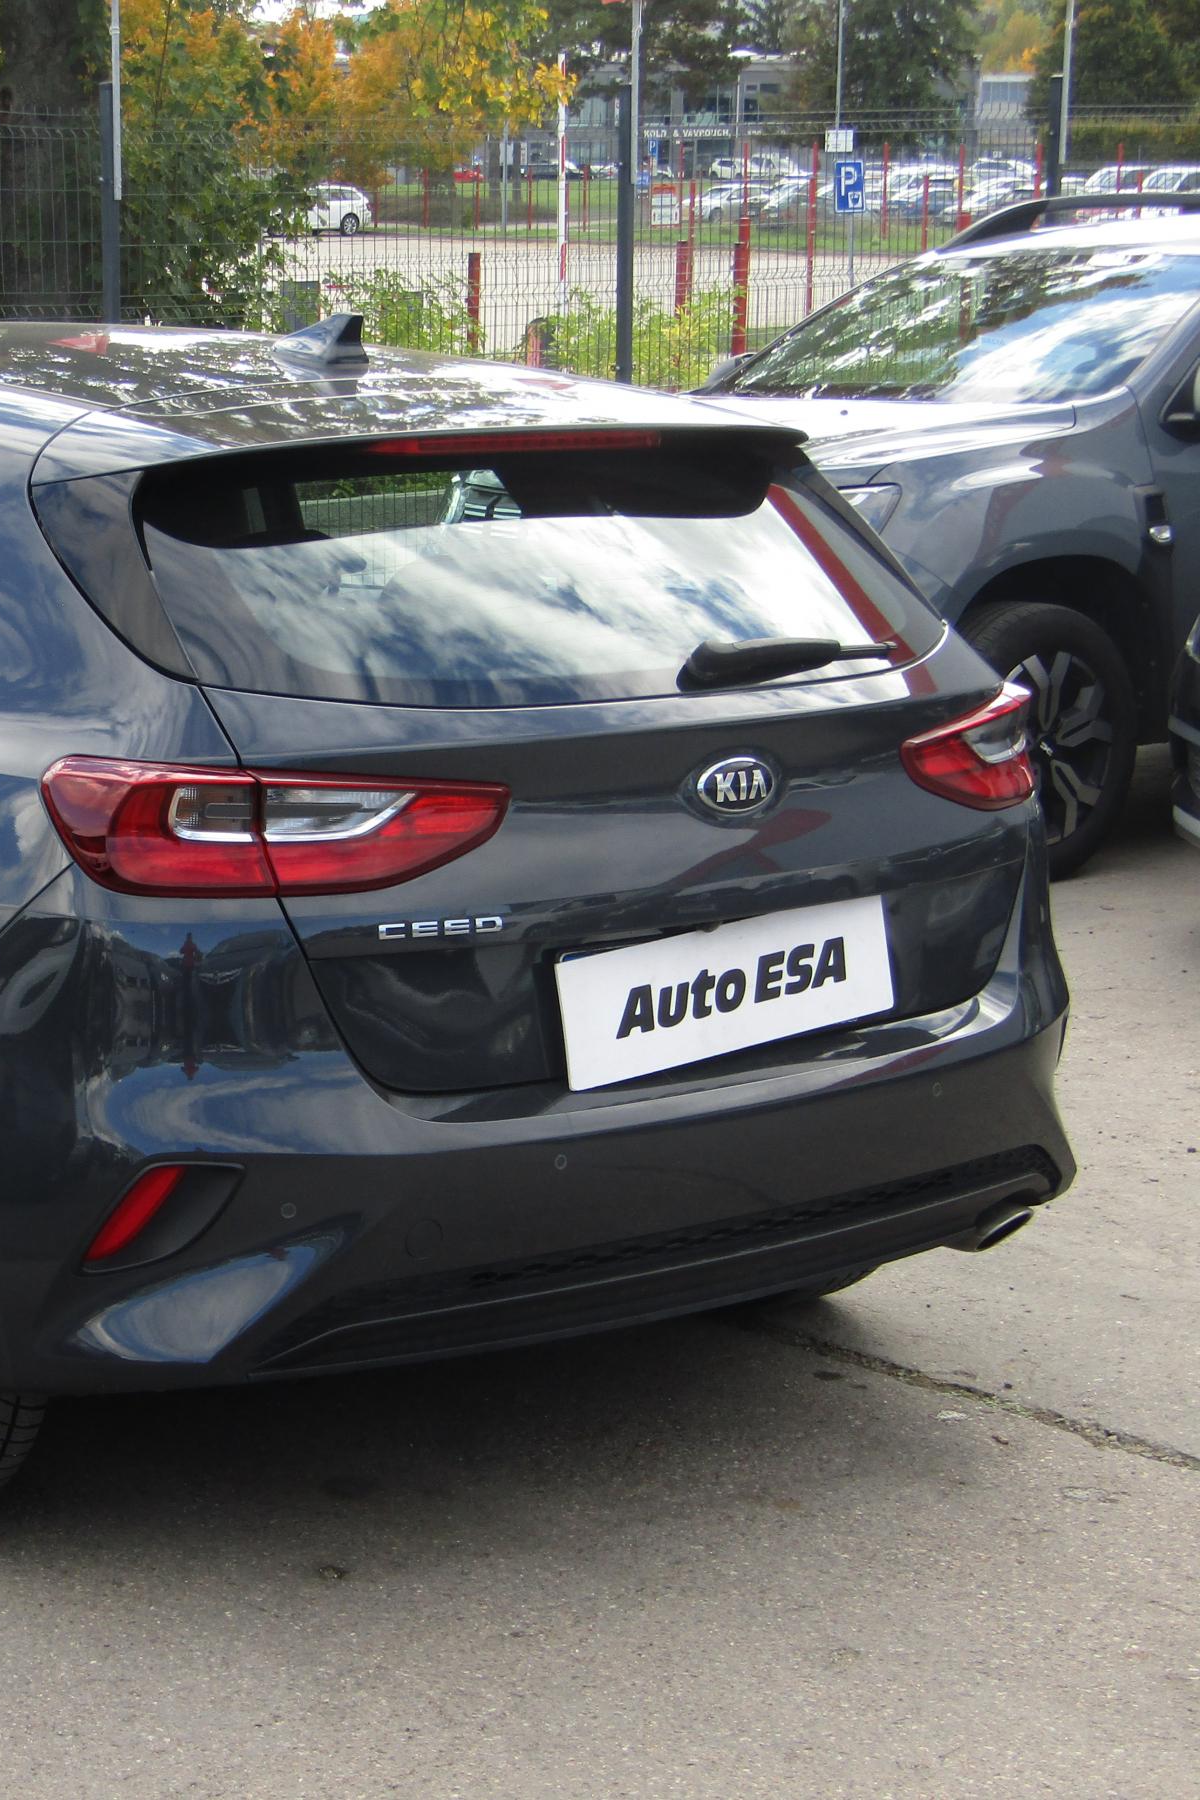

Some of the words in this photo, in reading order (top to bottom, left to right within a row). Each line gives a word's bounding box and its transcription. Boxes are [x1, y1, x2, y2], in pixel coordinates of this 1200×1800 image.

[840, 166, 857, 196] P
[714, 769, 767, 803] KIA
[378, 916, 503, 940] CEED
[616, 968, 747, 1040] Auto
[754, 936, 847, 1004] ESA
